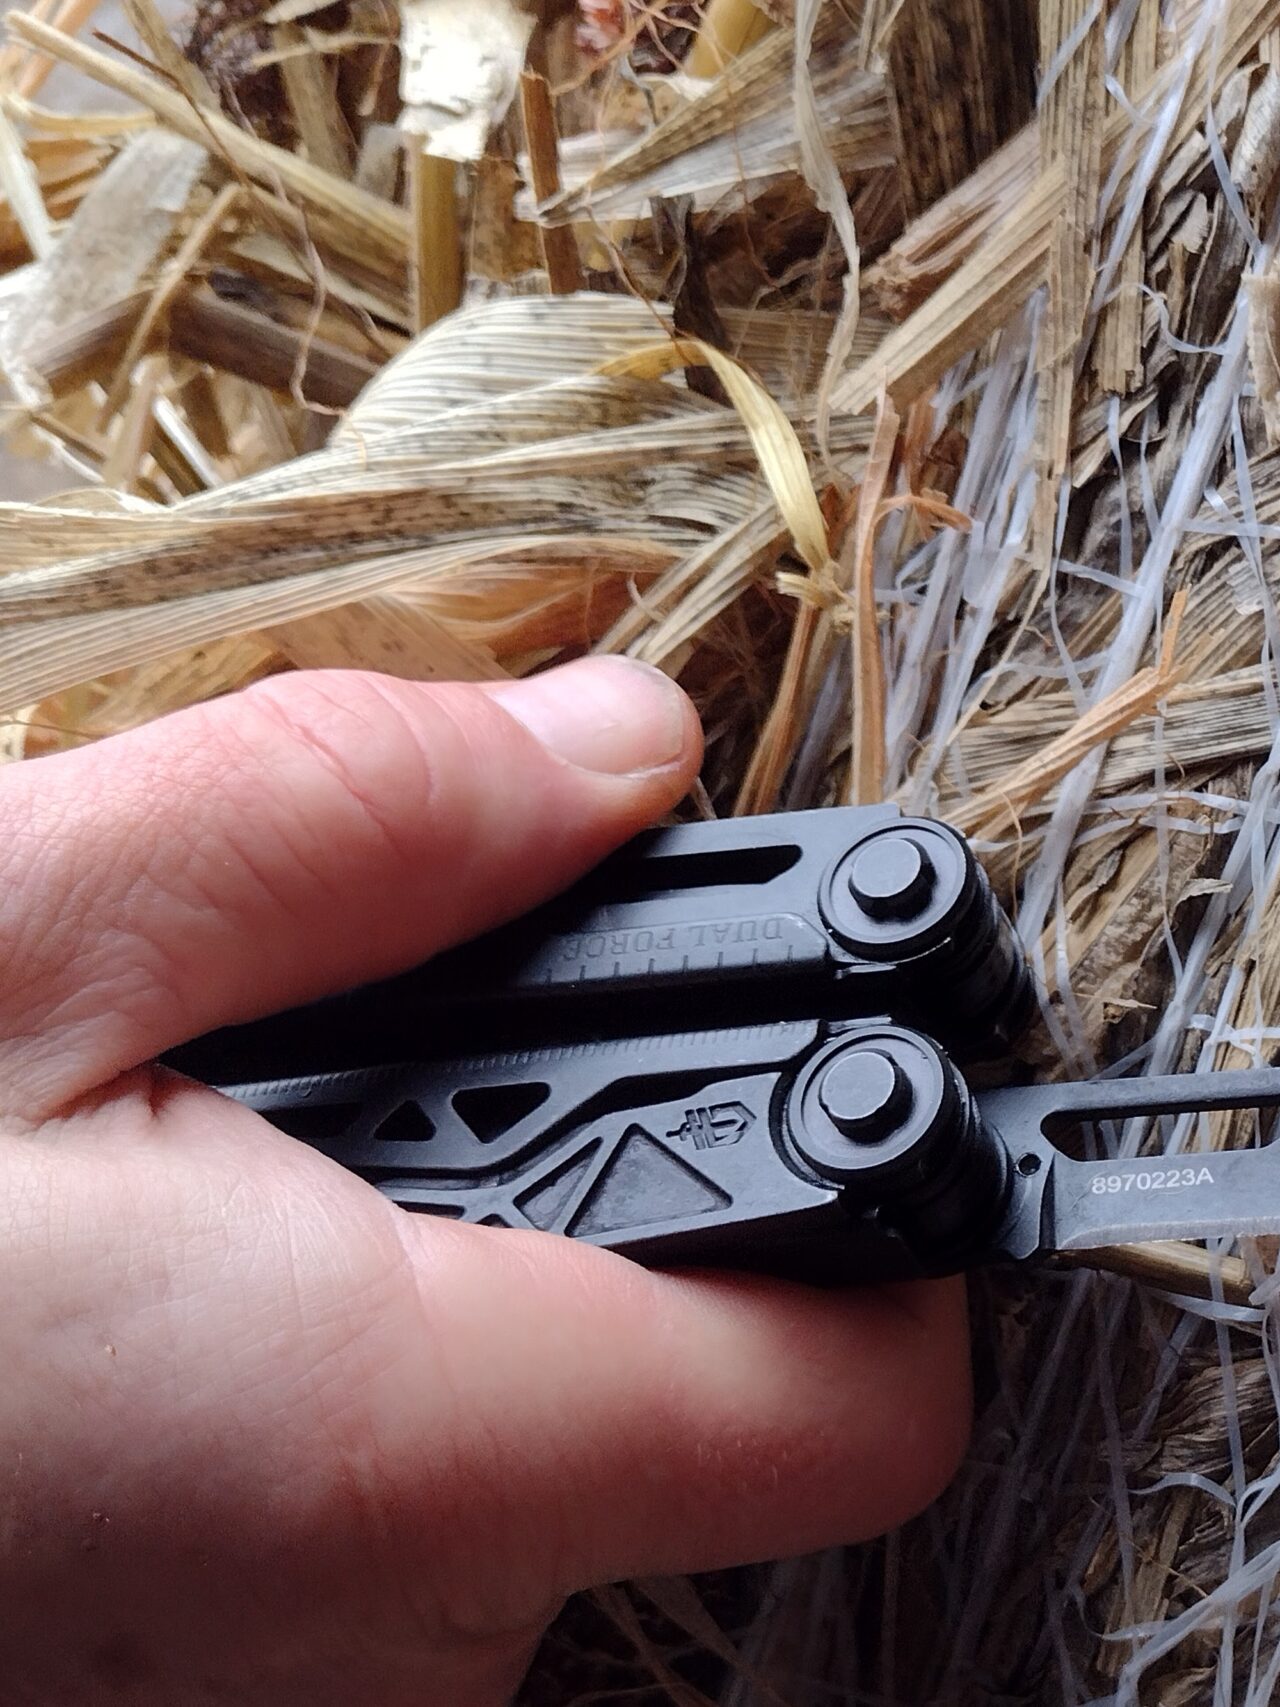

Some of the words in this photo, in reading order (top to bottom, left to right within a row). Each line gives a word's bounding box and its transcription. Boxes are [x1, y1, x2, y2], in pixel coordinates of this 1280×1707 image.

[560, 928, 676, 961] FORCE
[689, 917, 786, 947] DUAL
[1091, 1167, 1215, 1195] 8970223A
